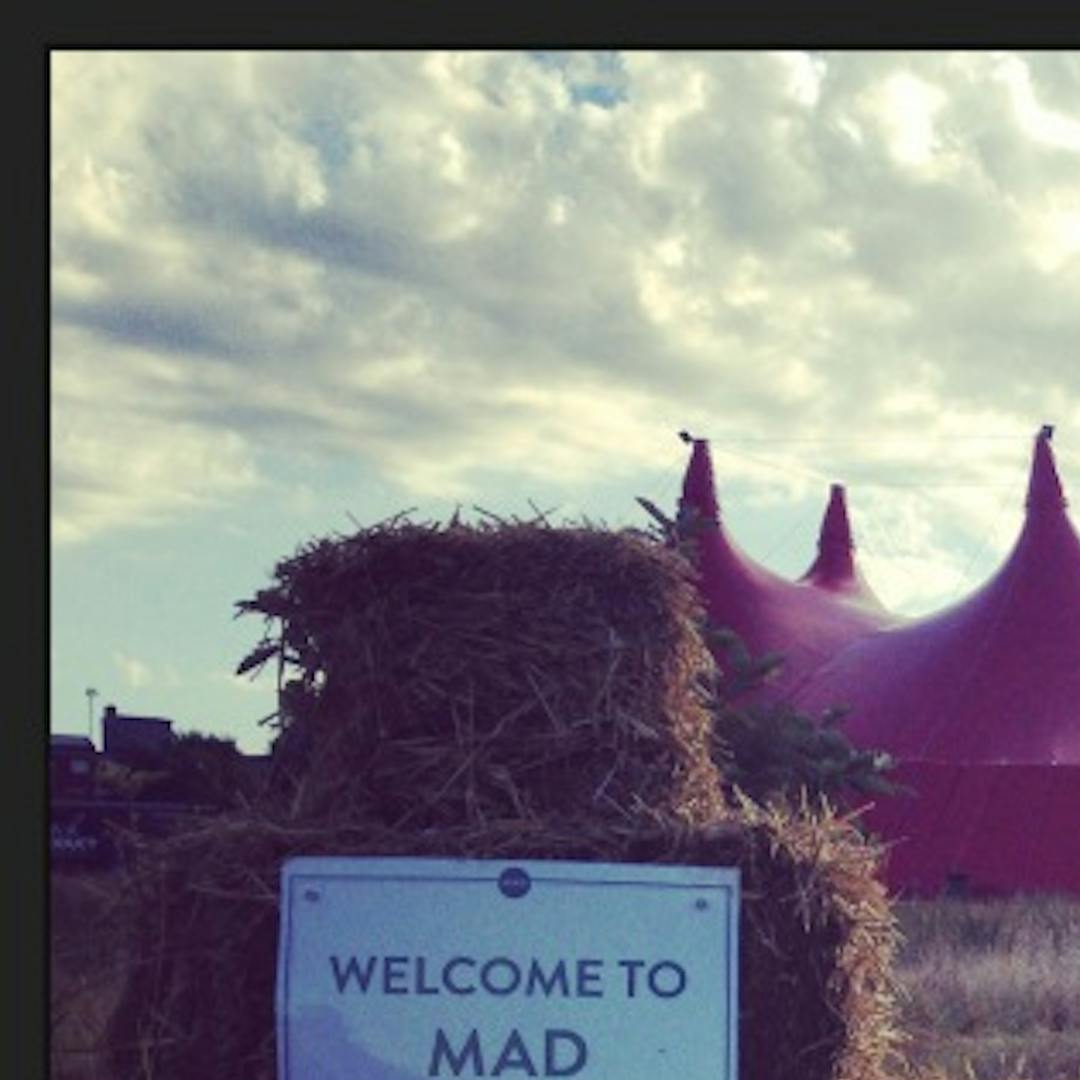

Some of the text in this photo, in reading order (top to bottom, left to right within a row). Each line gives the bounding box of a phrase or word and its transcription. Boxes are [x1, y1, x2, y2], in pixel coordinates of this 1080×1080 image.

[328, 954, 688, 998] WELCOME TO
[428, 1028, 589, 1077] MAD
